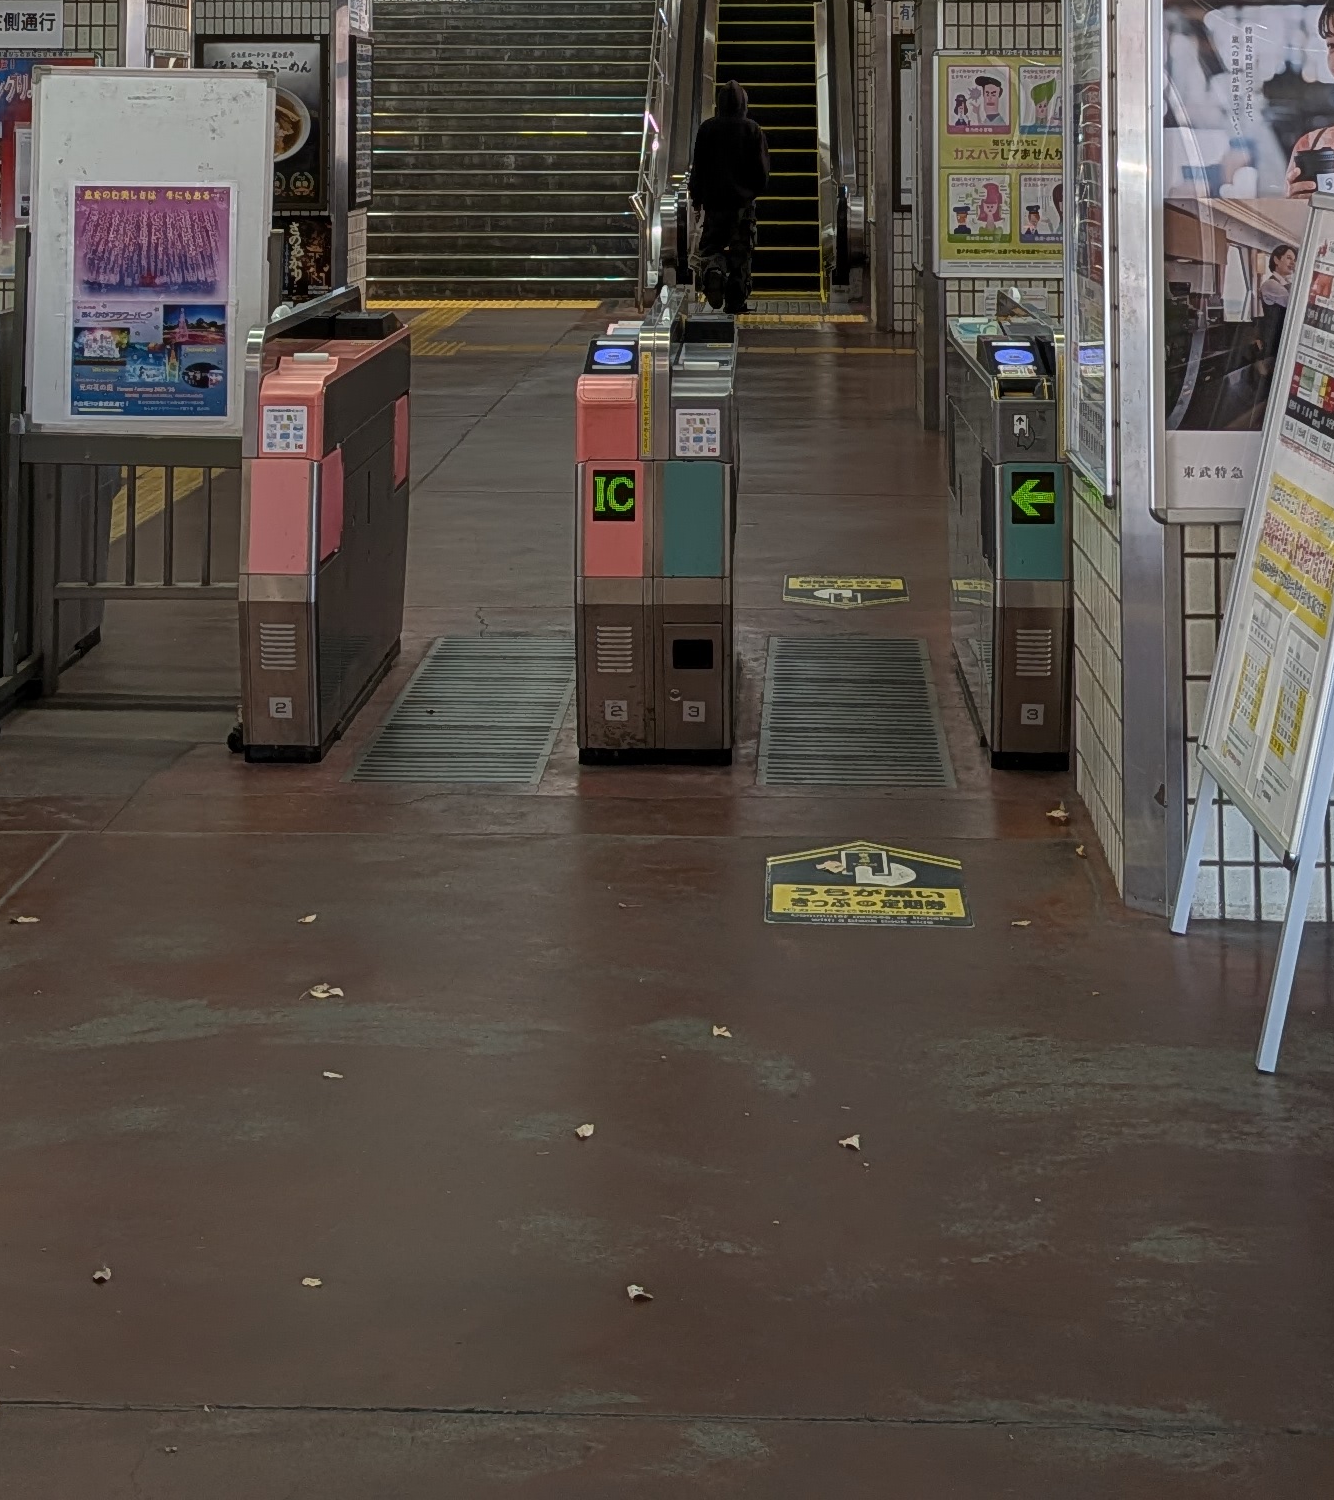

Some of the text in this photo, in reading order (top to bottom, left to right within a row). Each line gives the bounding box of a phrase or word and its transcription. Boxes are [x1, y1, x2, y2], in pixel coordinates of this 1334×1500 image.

[1182, 465, 1244, 481] 東武特急
[595, 475, 634, 513] IC
[275, 702, 288, 715] 2
[688, 705, 701, 718] 3
[1026, 708, 1039, 720] 3
